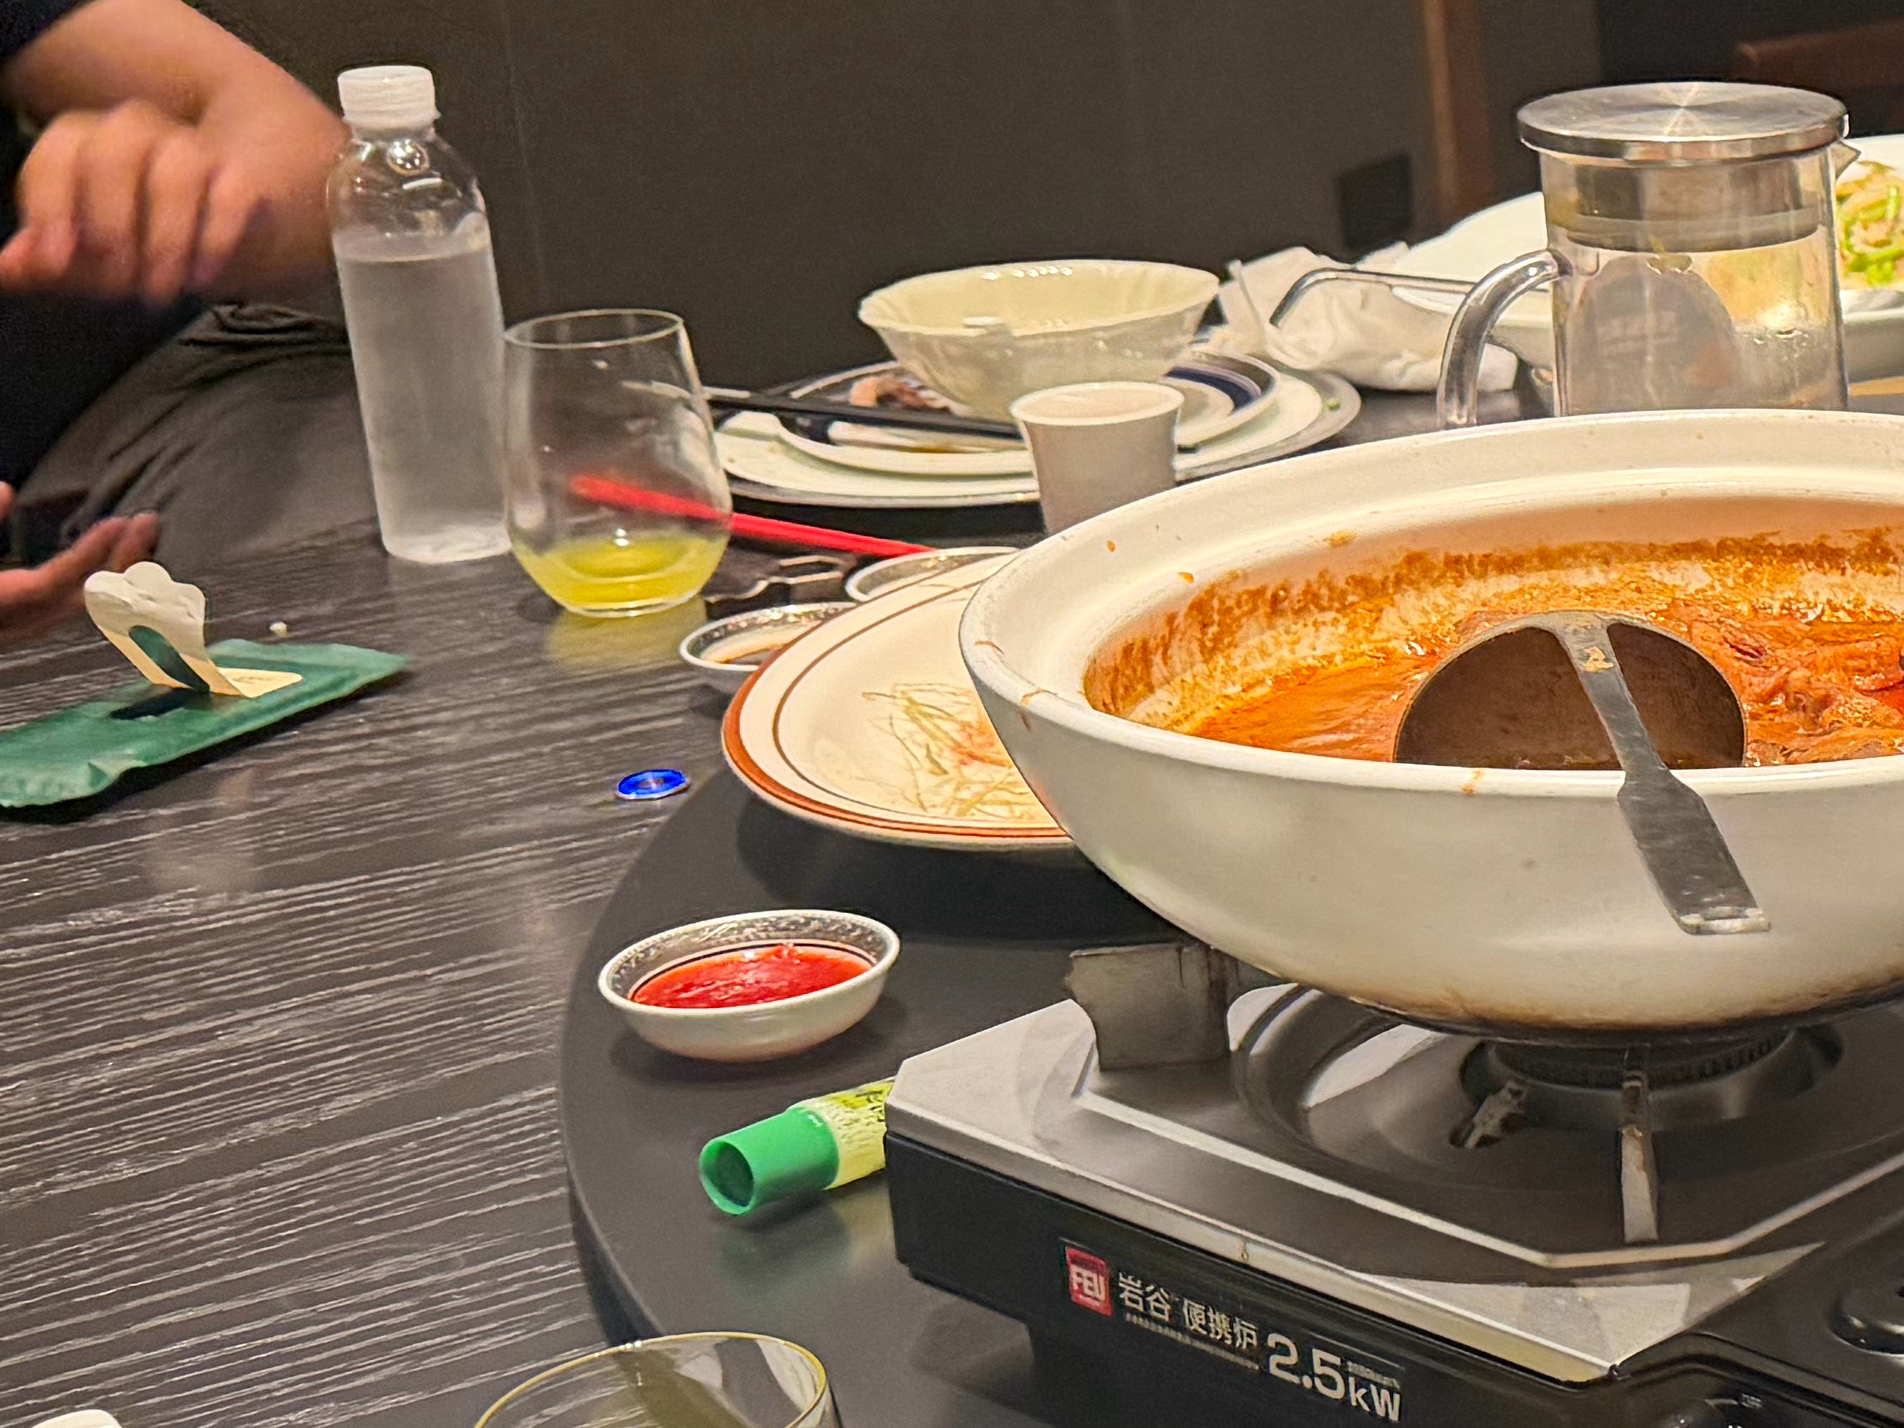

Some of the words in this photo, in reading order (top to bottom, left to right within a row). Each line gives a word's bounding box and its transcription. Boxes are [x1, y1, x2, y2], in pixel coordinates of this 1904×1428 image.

[1118, 1271, 1171, 1322] 岩谷
[1183, 1297, 1259, 1349] 便携炉
